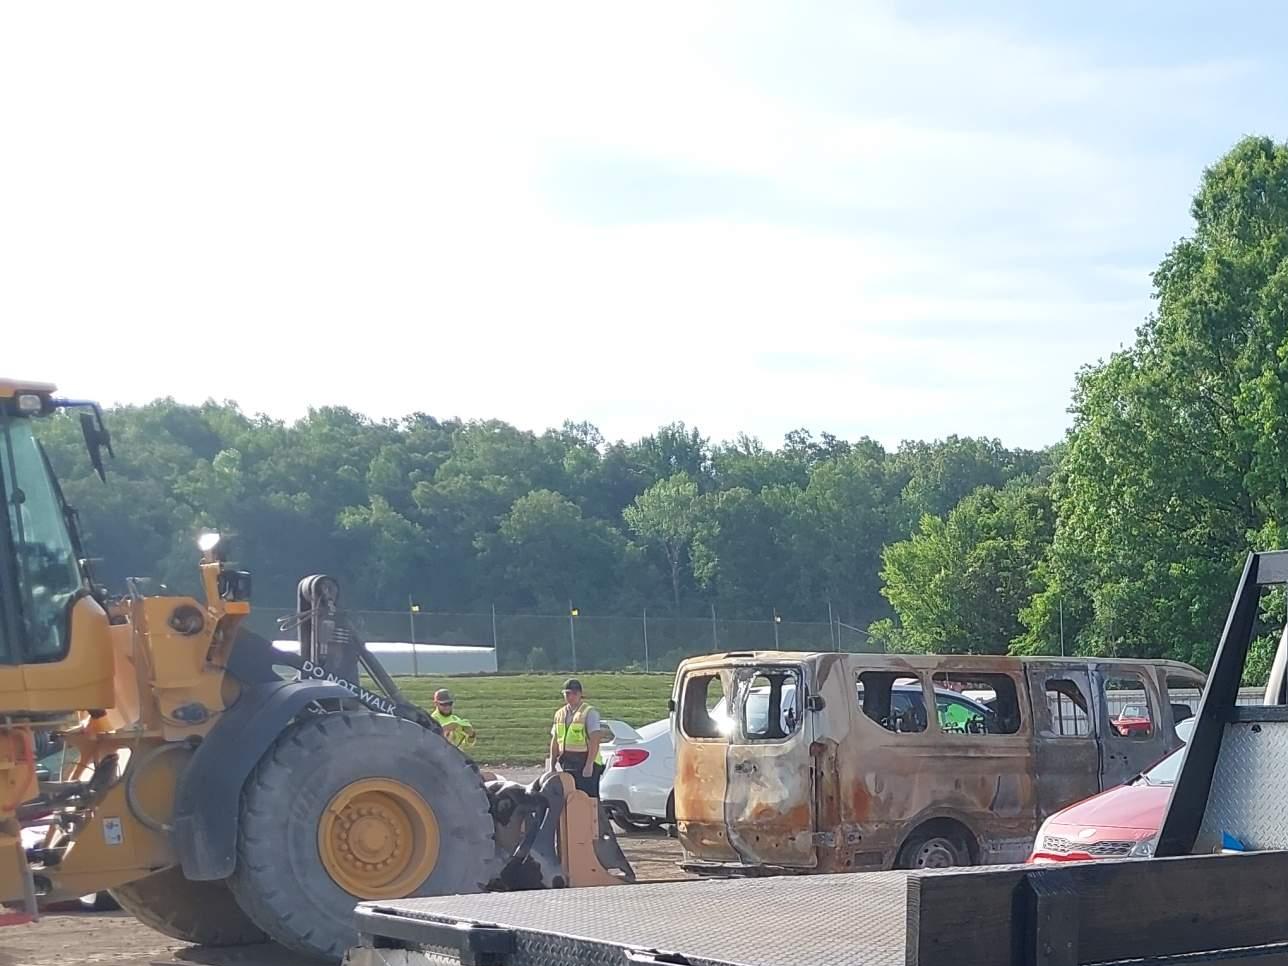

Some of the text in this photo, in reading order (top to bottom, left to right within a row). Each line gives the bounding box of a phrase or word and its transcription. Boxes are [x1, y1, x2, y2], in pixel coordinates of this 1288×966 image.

[302, 660, 325, 678] DO
[326, 673, 359, 697] NOT
[360, 689, 396, 717] WALK
